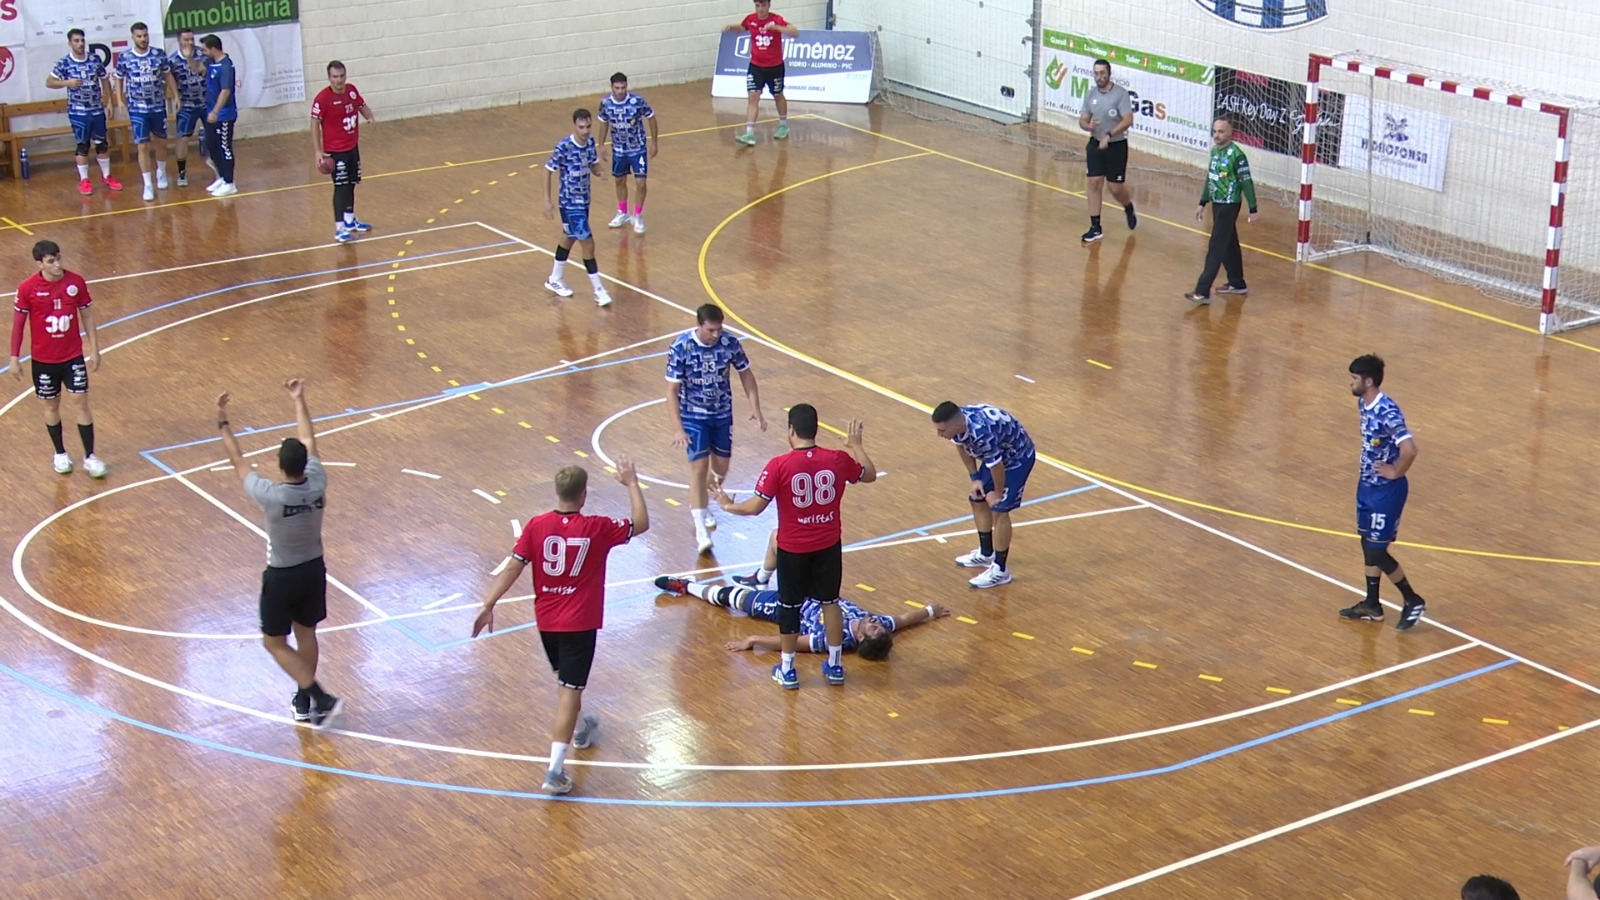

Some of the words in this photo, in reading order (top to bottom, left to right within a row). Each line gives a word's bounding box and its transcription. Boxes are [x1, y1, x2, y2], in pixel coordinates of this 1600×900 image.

[167, 0, 291, 30] inmobiliaria
[811, 61, 837, 69] ALUMINIO
[1241, 98, 1259, 120] Key
[791, 469, 836, 509] 98
[1370, 513, 1387, 530] 15
[542, 535, 591, 577] 97
